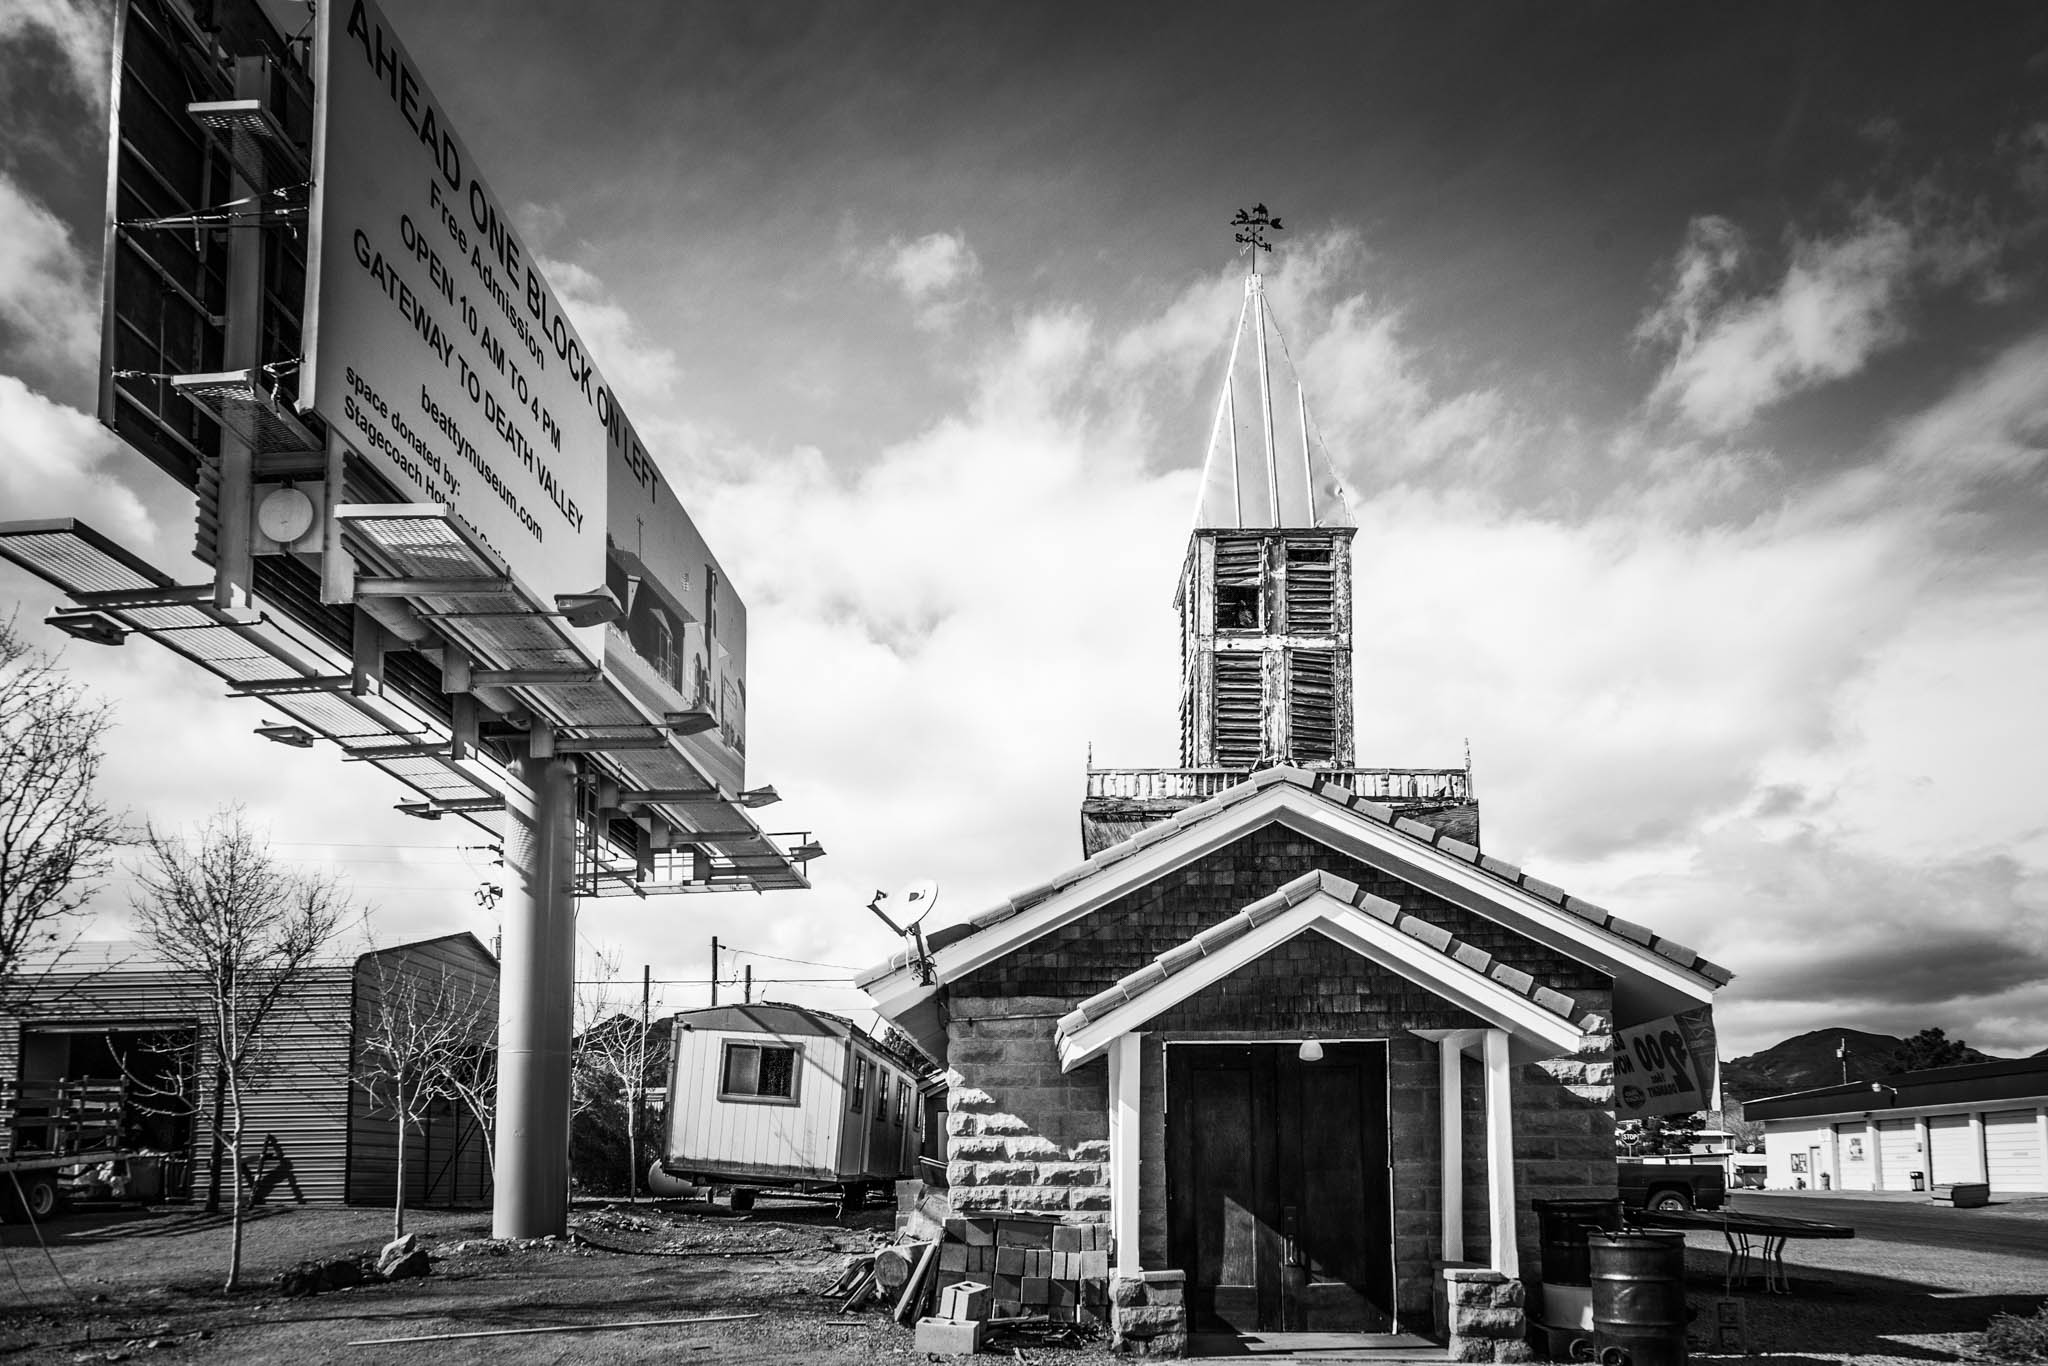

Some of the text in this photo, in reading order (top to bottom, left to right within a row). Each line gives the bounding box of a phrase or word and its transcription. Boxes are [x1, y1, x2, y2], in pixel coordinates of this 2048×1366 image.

[347, 0, 658, 505] AHEAD ONE BLOCK ON LEFT
[400, 214, 560, 453] OPEN 10 AM TO 4 PM
[430, 178, 544, 371] Free Admission
[344, 395, 423, 488] Stagecoach
[345, 366, 460, 497] space donated by:
[353, 228, 584, 535] GATEWAY TO DEATH VALLEY
[421, 383, 543, 544] beattymuseum.com
[1623, 1133, 1638, 1141] STOP
